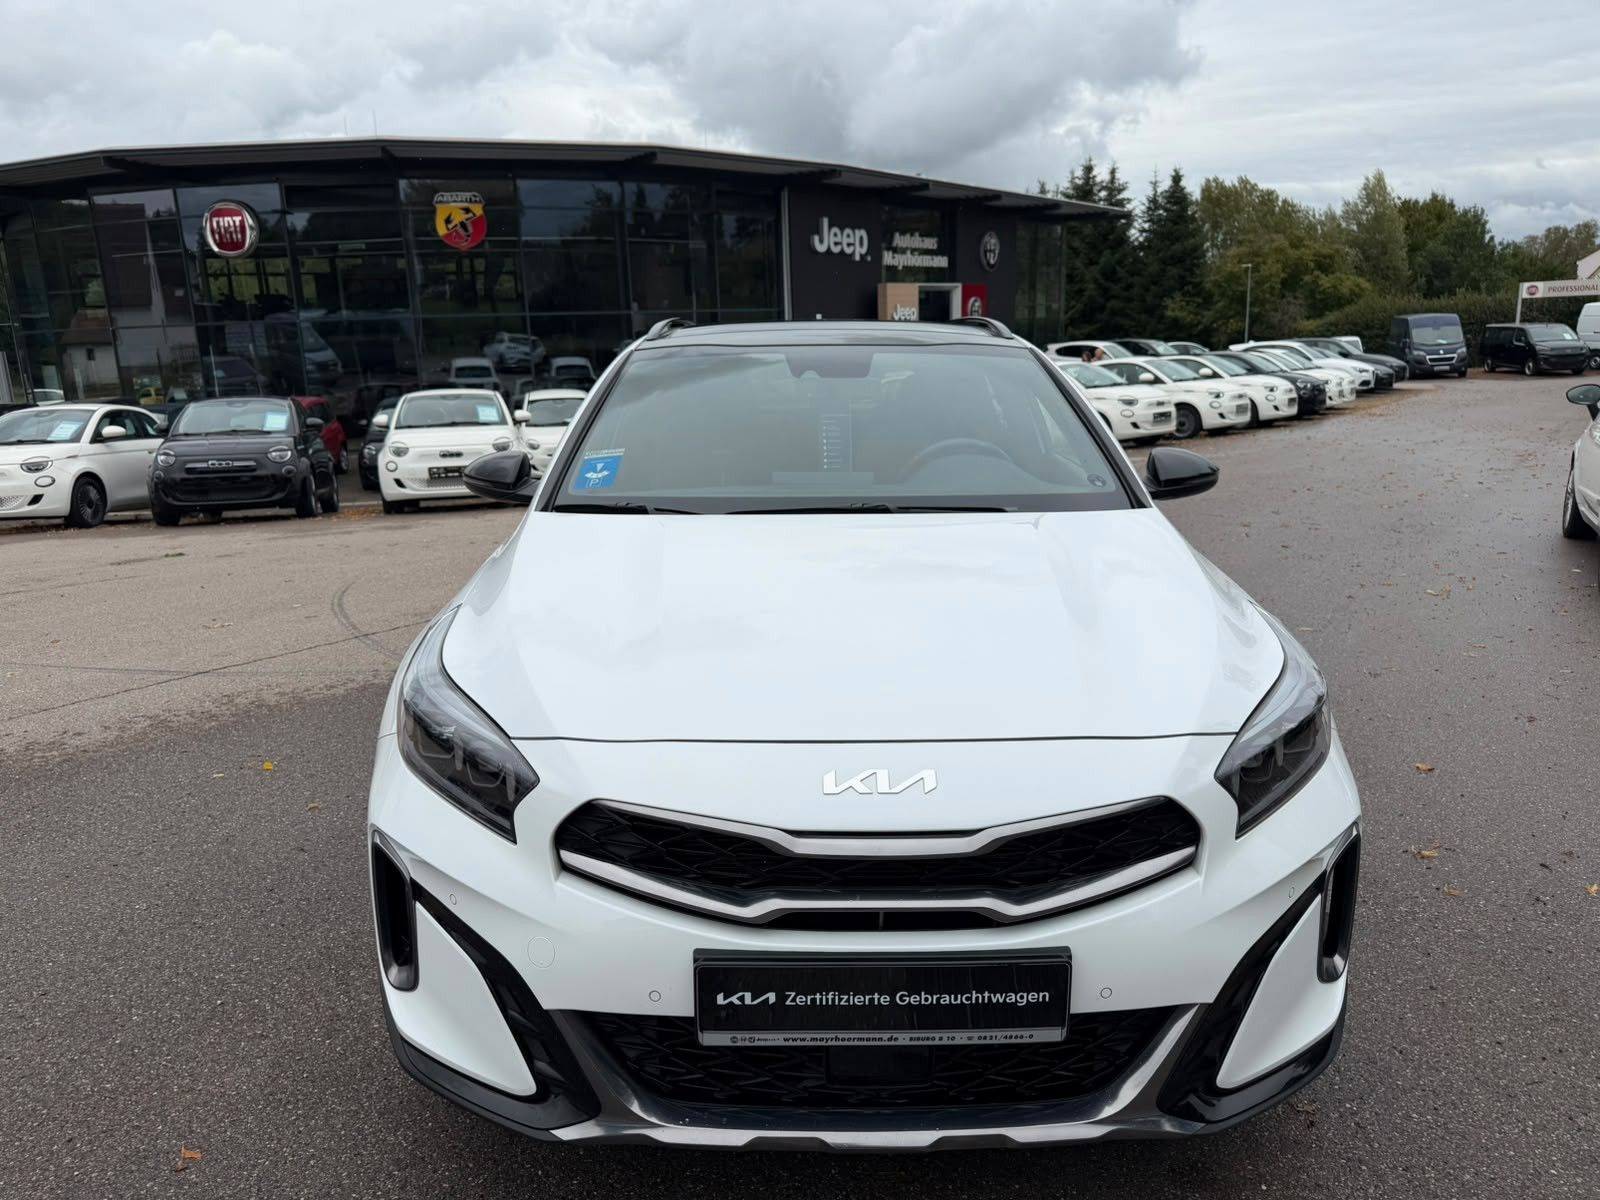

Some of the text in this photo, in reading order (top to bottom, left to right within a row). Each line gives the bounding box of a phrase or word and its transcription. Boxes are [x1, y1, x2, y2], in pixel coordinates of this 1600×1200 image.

[211, 216, 242, 243] FIAT
[811, 217, 869, 261] Jeep
[892, 232, 938, 250] Autohaus
[1547, 284, 1599, 294] PROFESSIONAL
[893, 303, 917, 321] Jeep
[822, 768, 938, 796] KIA
[716, 990, 1050, 1006] KIA Zertifizierte Gebrauchtwagen
[783, 1034, 899, 1044] www.mayrhoermann.de
